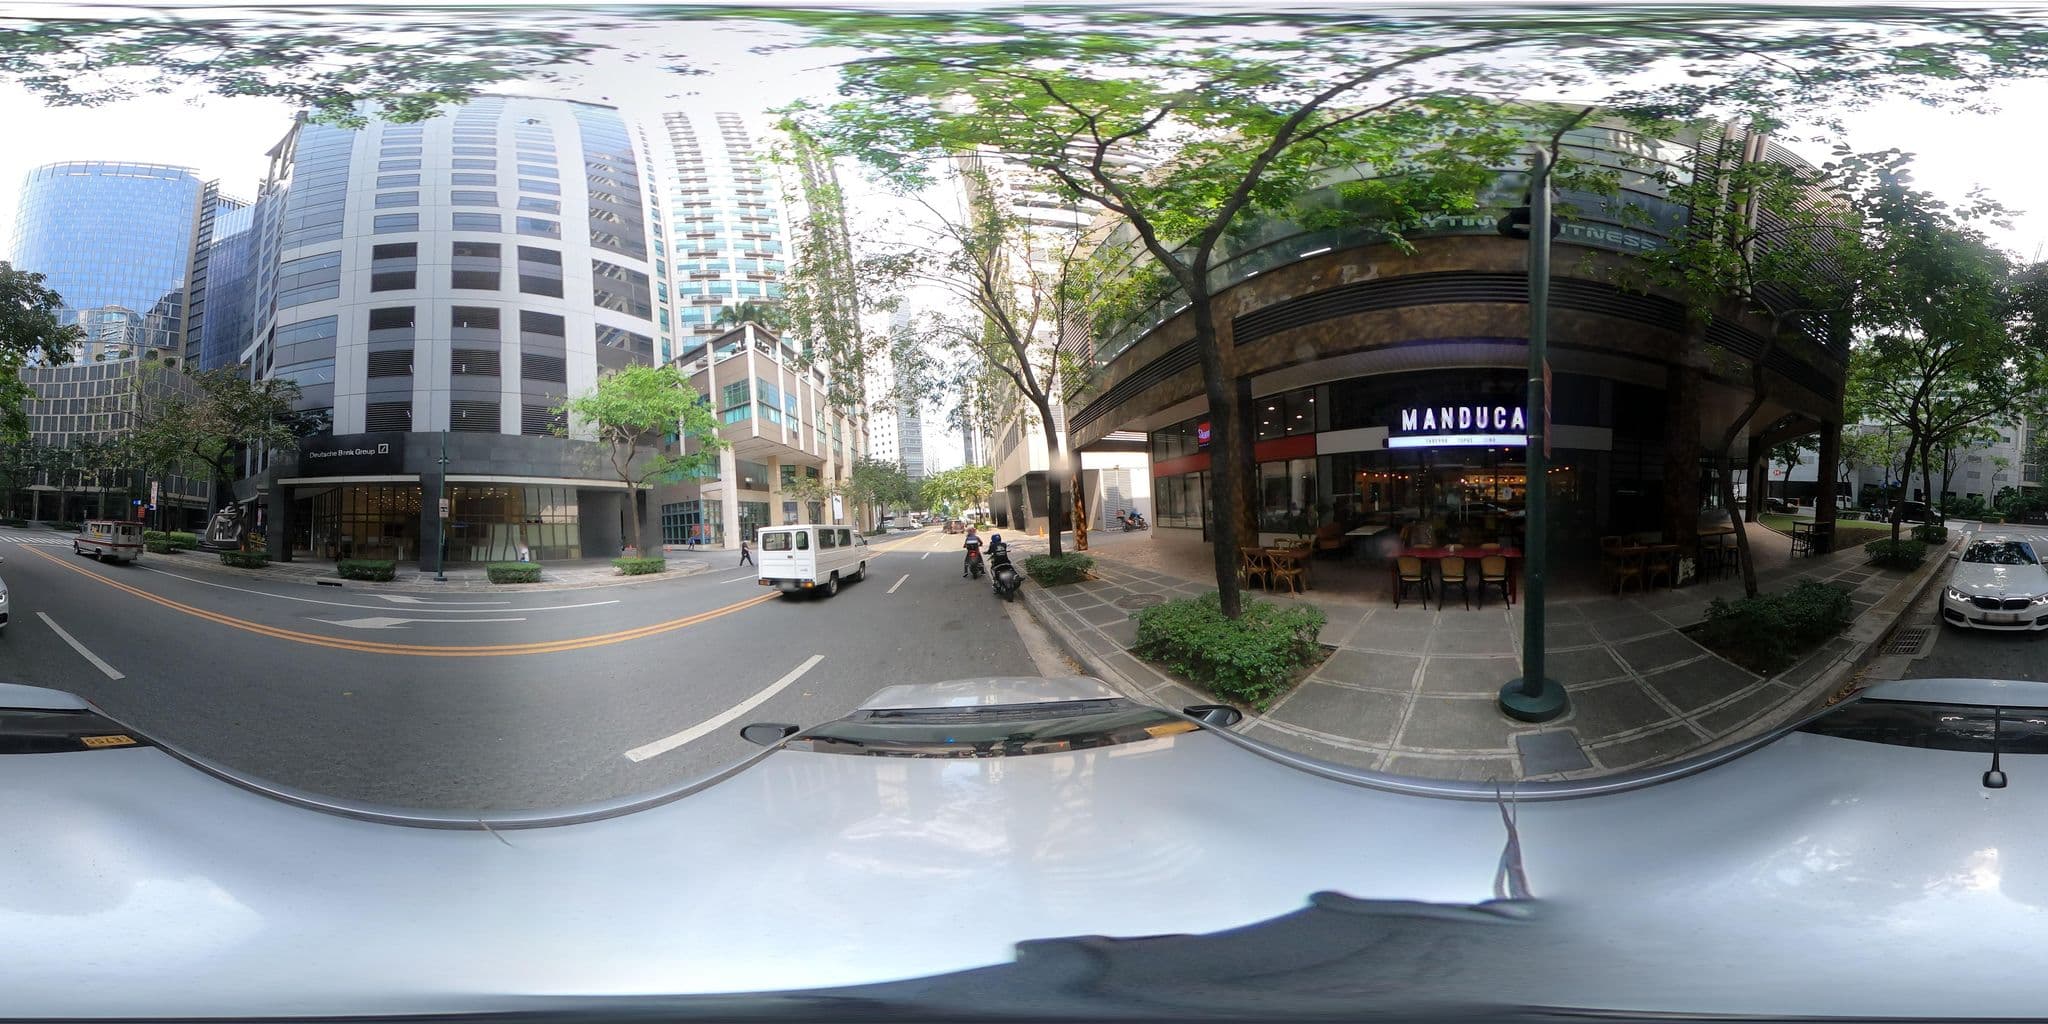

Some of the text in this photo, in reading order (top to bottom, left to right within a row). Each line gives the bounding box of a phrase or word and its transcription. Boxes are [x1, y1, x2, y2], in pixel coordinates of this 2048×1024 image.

[1560, 223, 1657, 251] ITNESS
[1402, 406, 1525, 431] MANDUCA
[309, 451, 337, 459] Deutsche
[355, 448, 376, 457] Group
